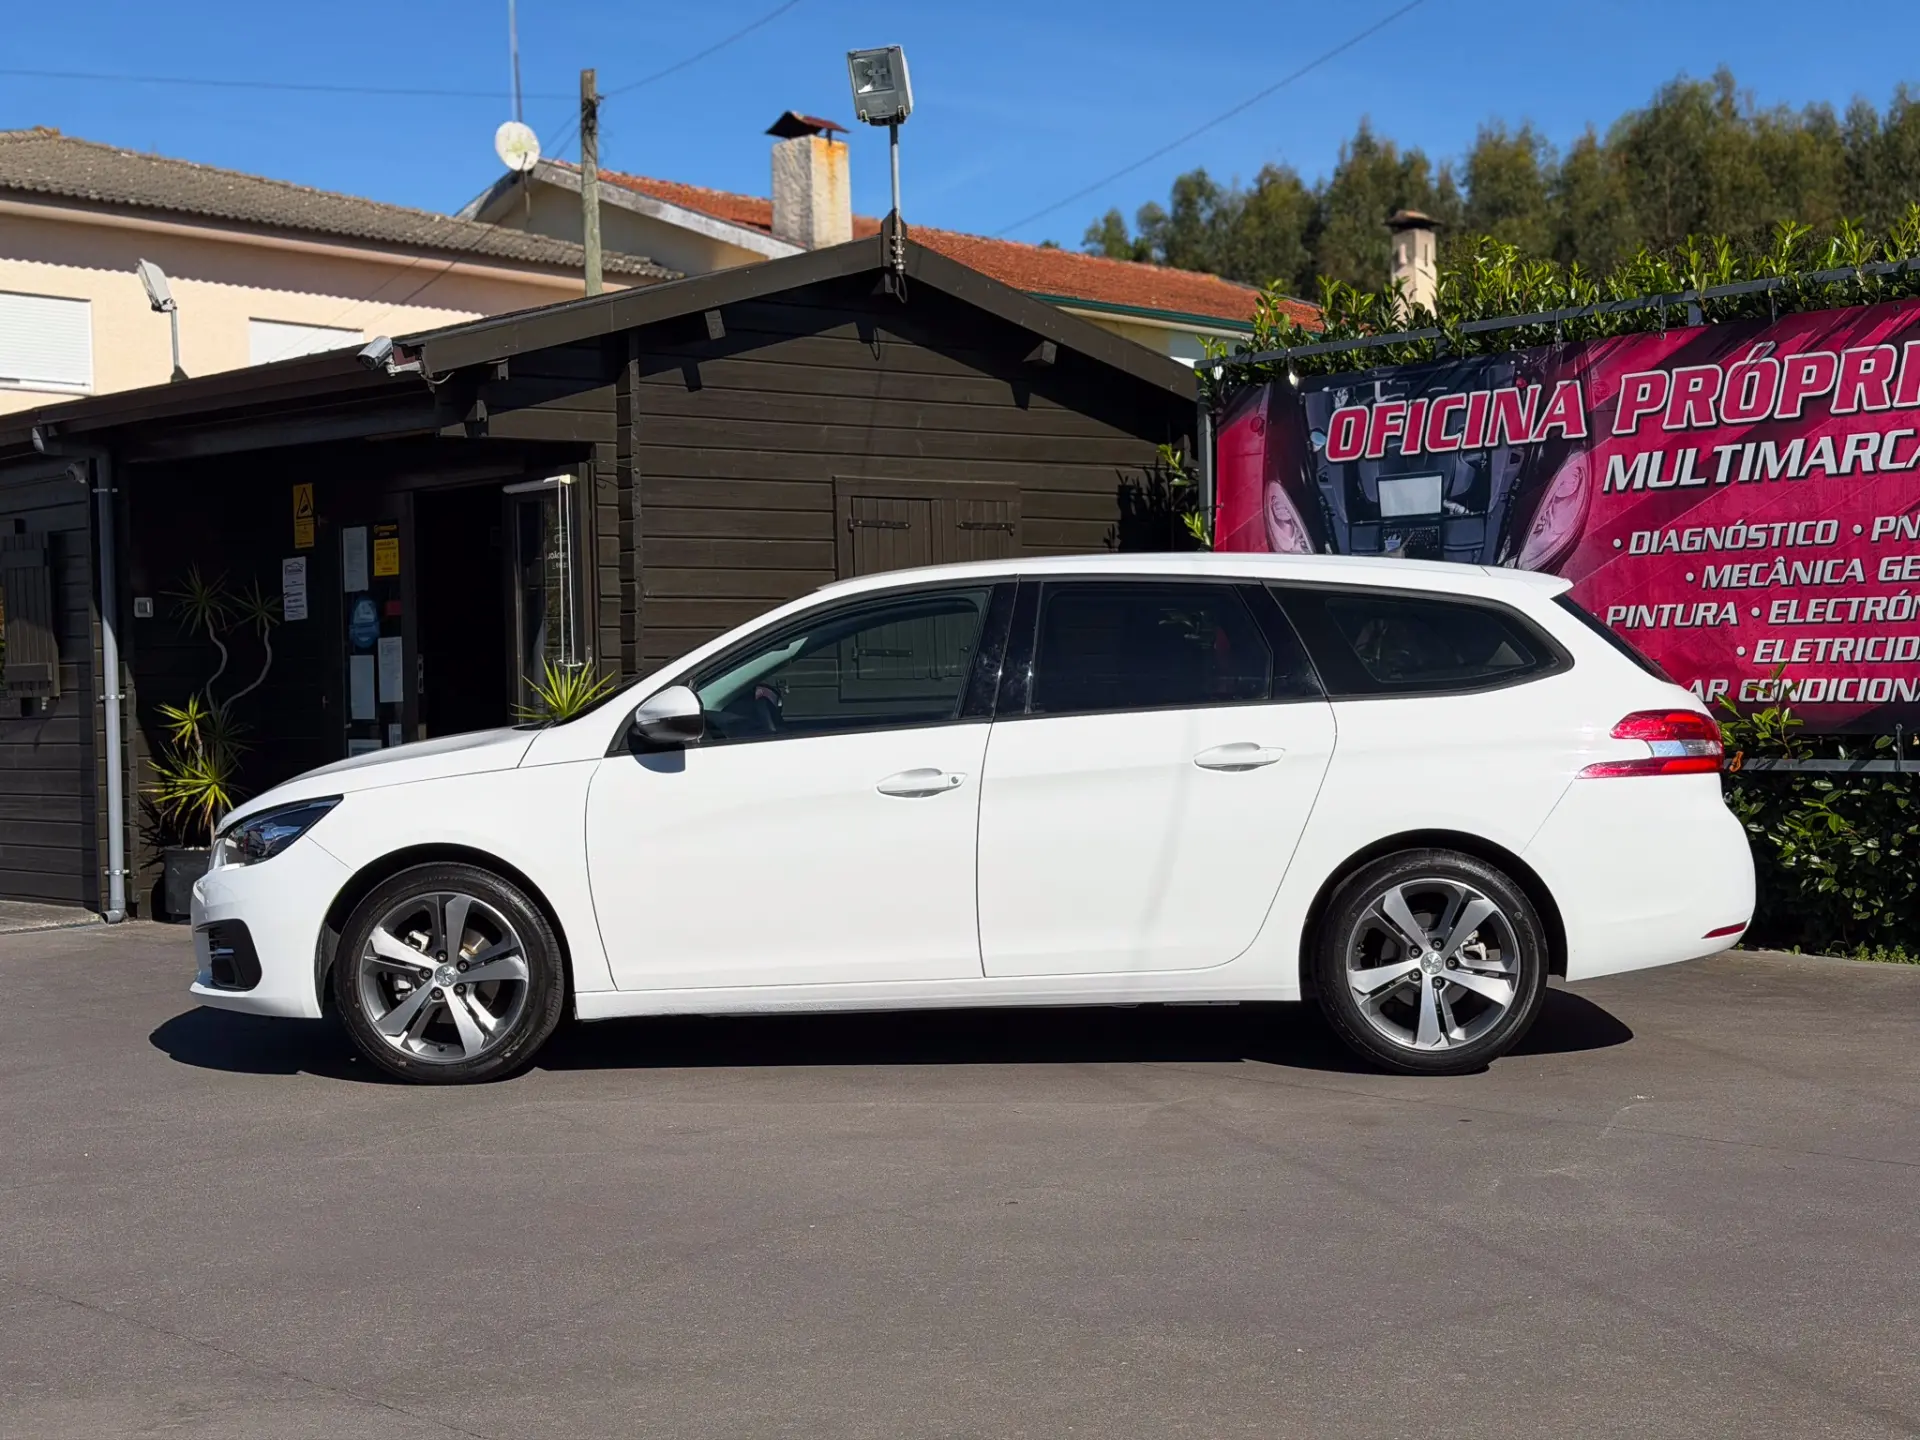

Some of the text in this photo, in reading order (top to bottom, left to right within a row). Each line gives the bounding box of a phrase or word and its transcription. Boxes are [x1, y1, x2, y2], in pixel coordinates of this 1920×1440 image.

[1326, 379, 1587, 462] OFICINA
[1628, 519, 1839, 555] DIAGNÓSTICO
[1701, 556, 1865, 589] MECÂNICA
[1607, 602, 1738, 628] PINTURA
[1689, 678, 1920, 702] AR CONDICION
